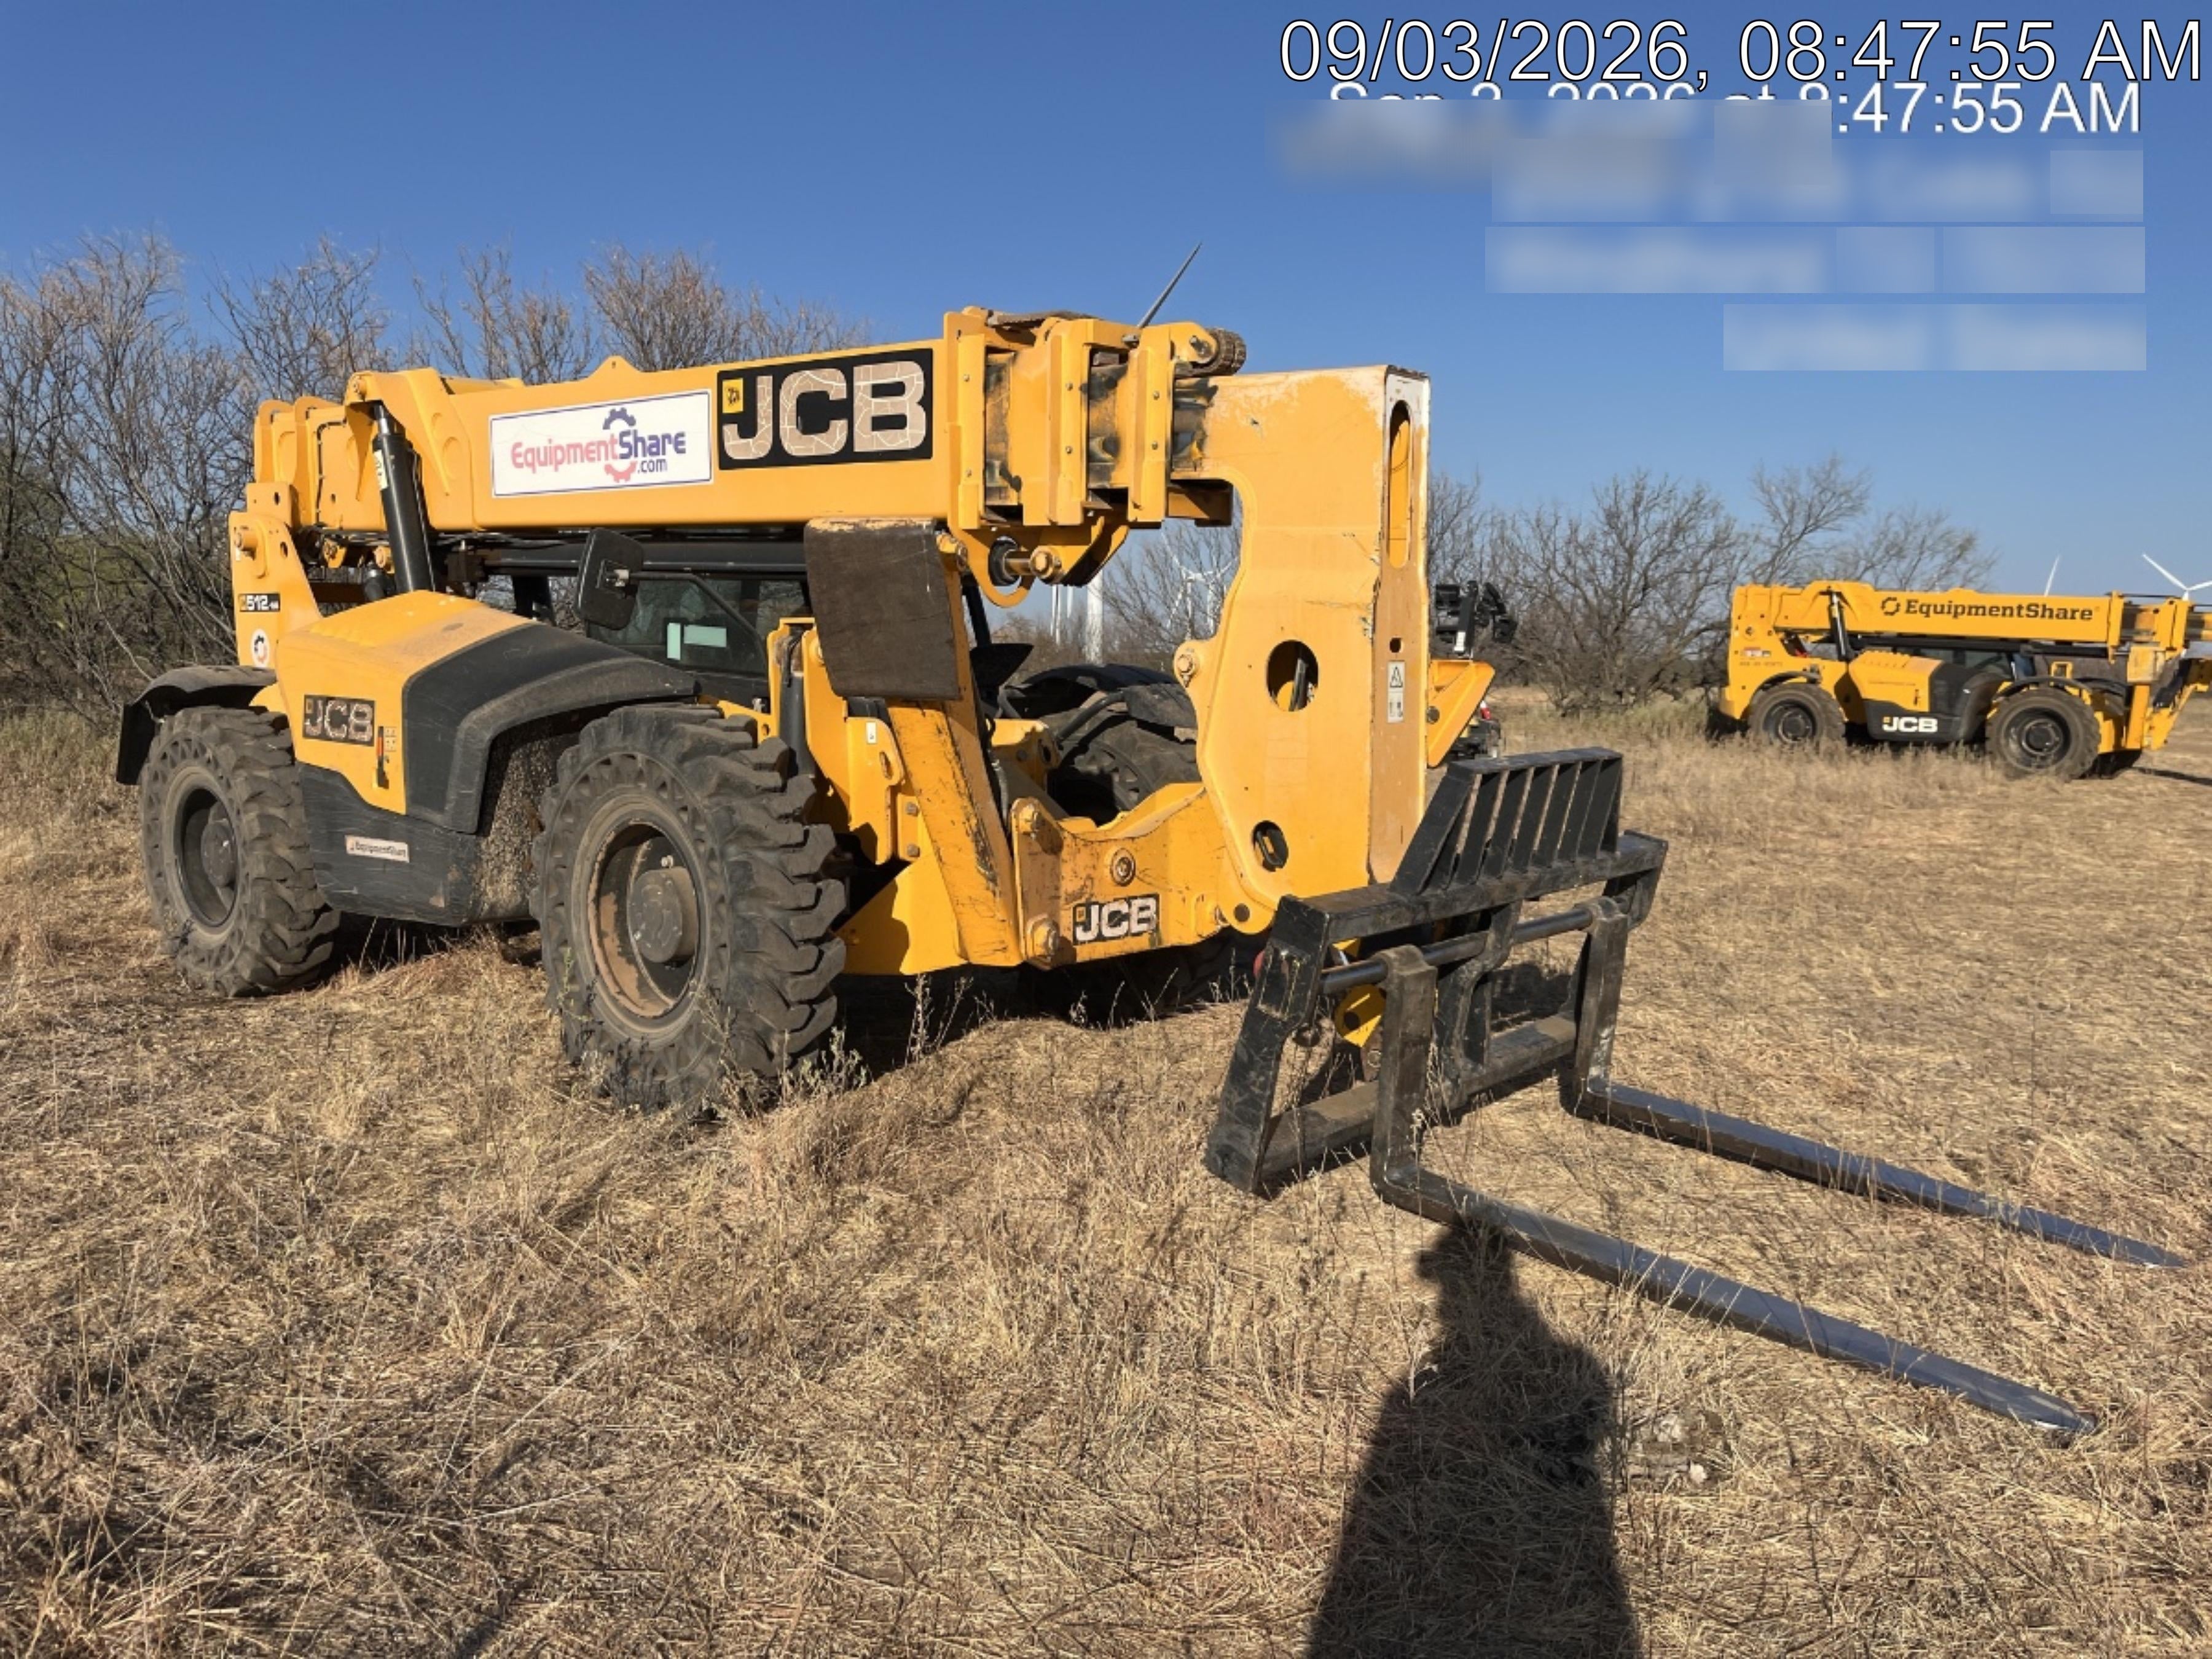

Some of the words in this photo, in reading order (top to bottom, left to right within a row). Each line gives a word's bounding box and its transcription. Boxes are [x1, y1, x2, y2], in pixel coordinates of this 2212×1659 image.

[722, 361, 927, 460] JCB
[511, 429, 686, 474] EquipmentShare
[637, 458, 668, 474] .com
[1905, 598, 2093, 621] EquipmentShare
[305, 699, 373, 742] JCB
[1882, 716, 1938, 732] JCB
[1075, 897, 1157, 941] JCB
